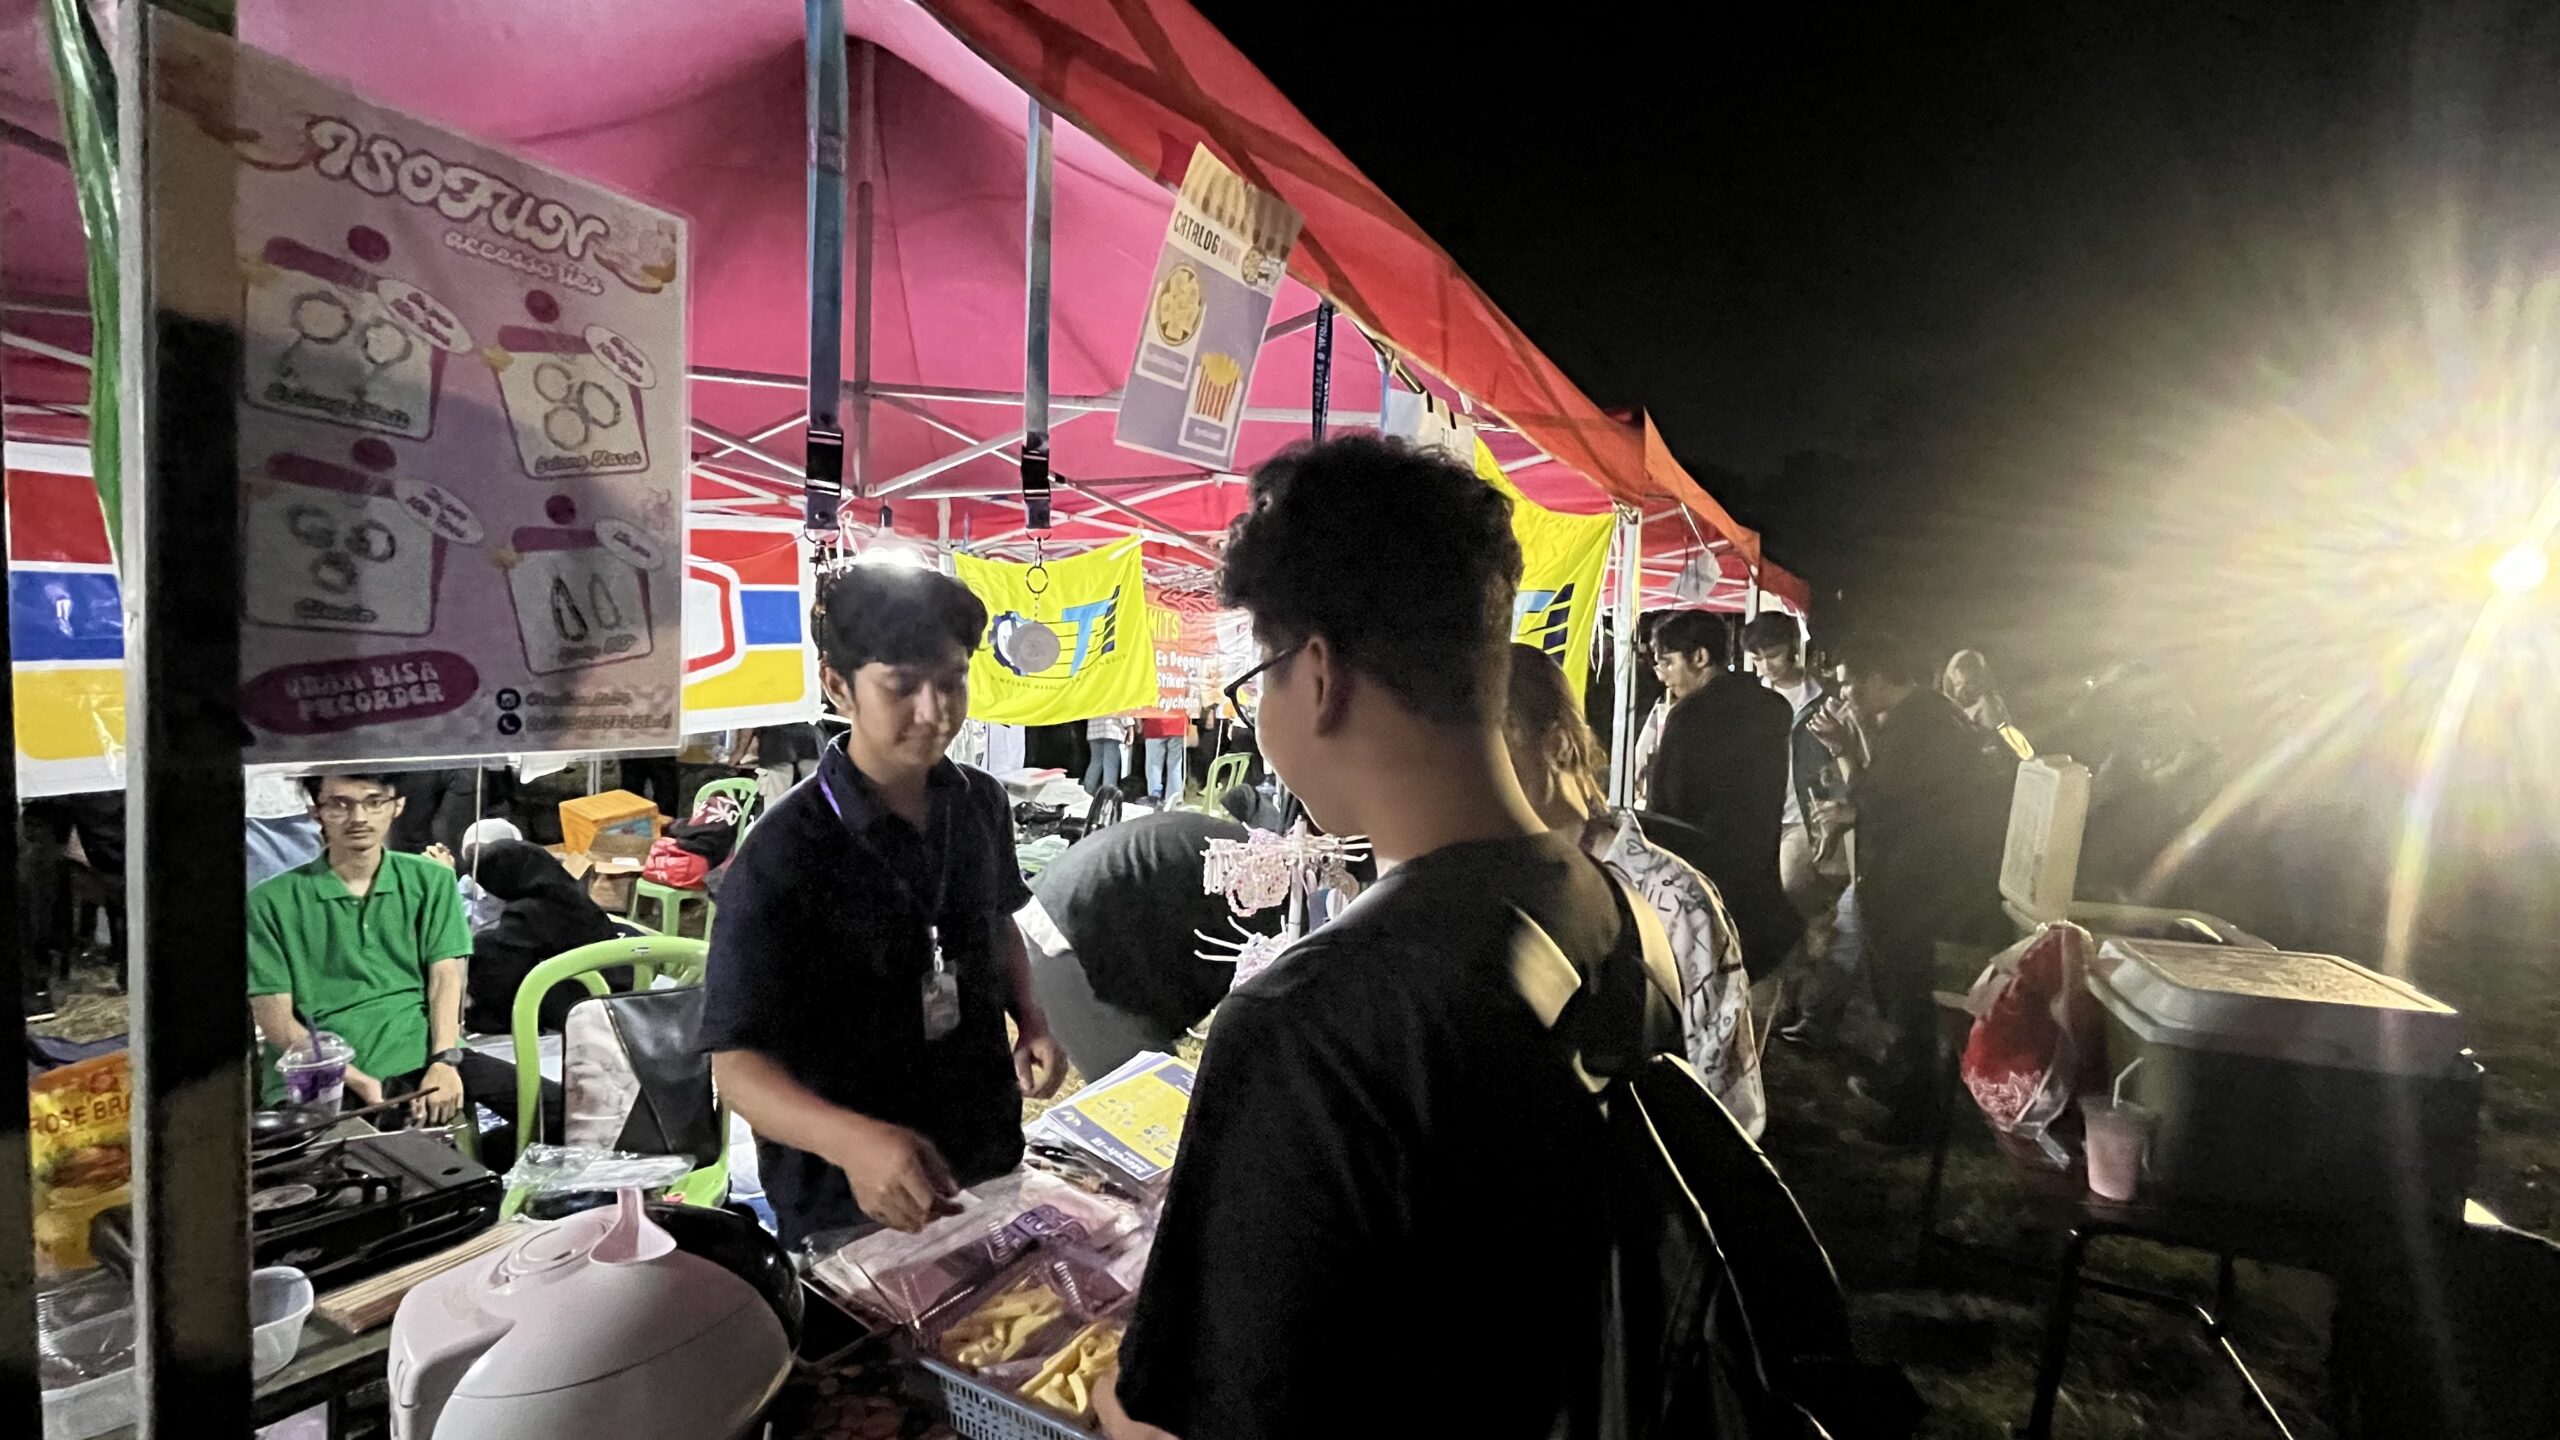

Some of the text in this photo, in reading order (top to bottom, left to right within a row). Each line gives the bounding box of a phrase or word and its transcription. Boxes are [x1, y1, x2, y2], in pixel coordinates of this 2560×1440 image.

[1173, 210, 1220, 254] CATALOG
[1317, 302, 1329, 350] USTRIAL
[371, 661, 439, 688] BISA
